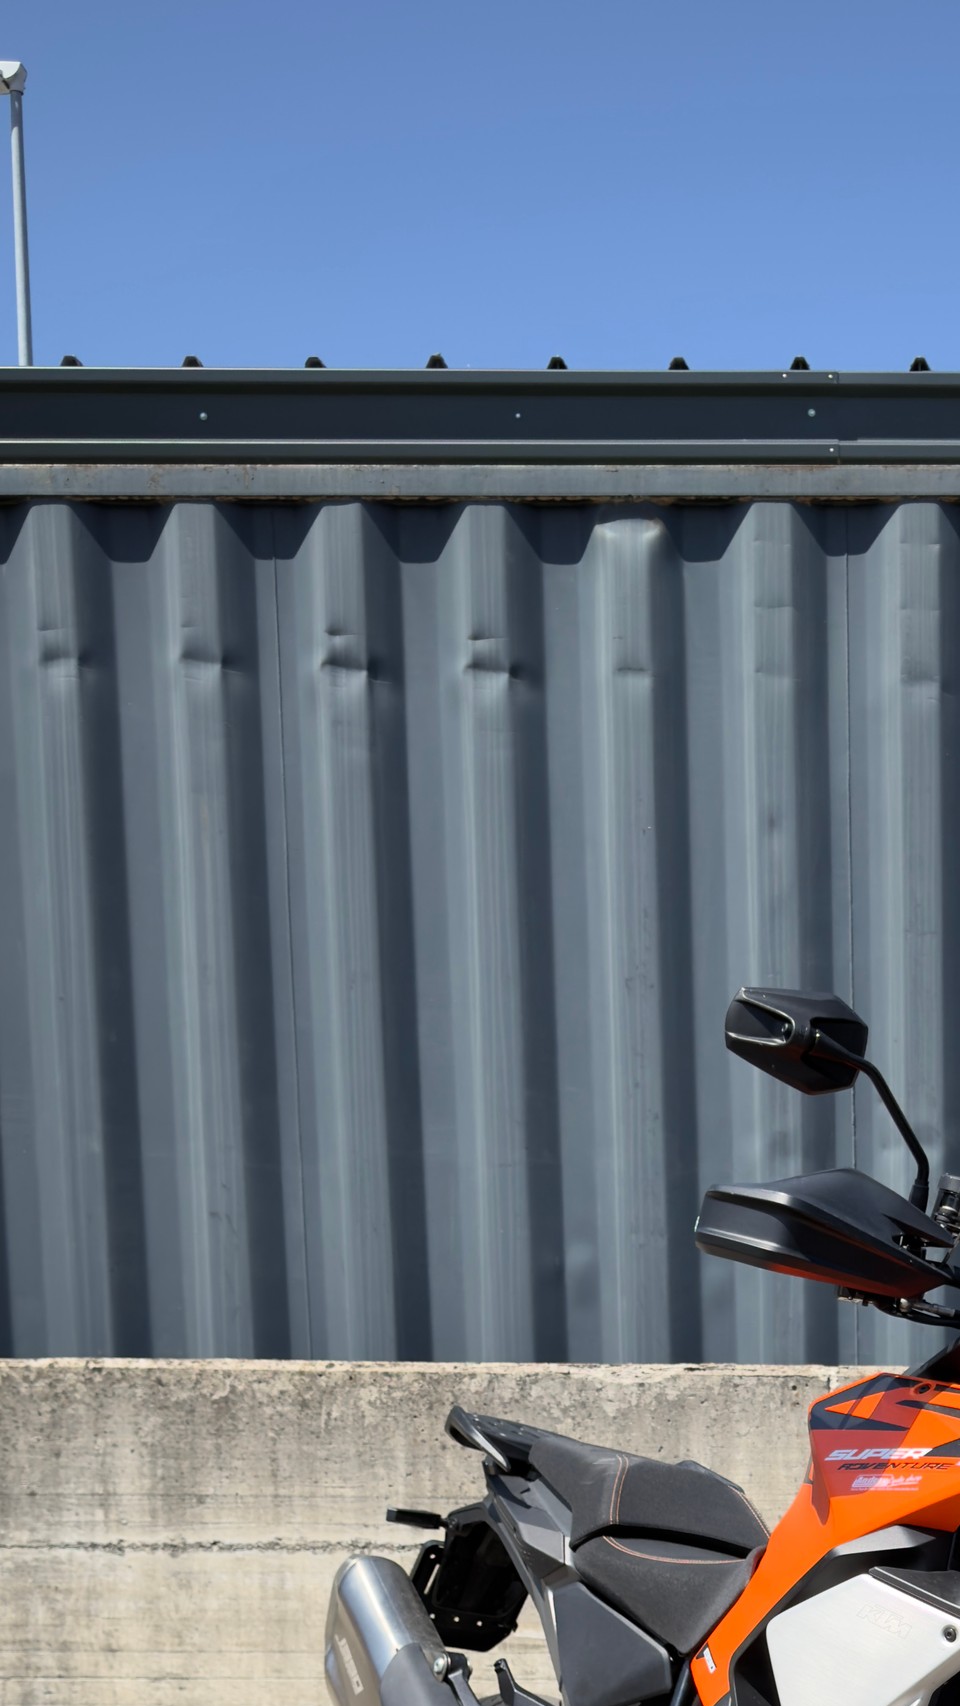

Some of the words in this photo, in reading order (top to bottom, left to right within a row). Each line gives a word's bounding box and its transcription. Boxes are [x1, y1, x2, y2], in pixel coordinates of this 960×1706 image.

[824, 1447, 934, 1461] SUPER
[838, 1462, 953, 1471] ADVENTURE
[856, 1603, 913, 1639] KTM
